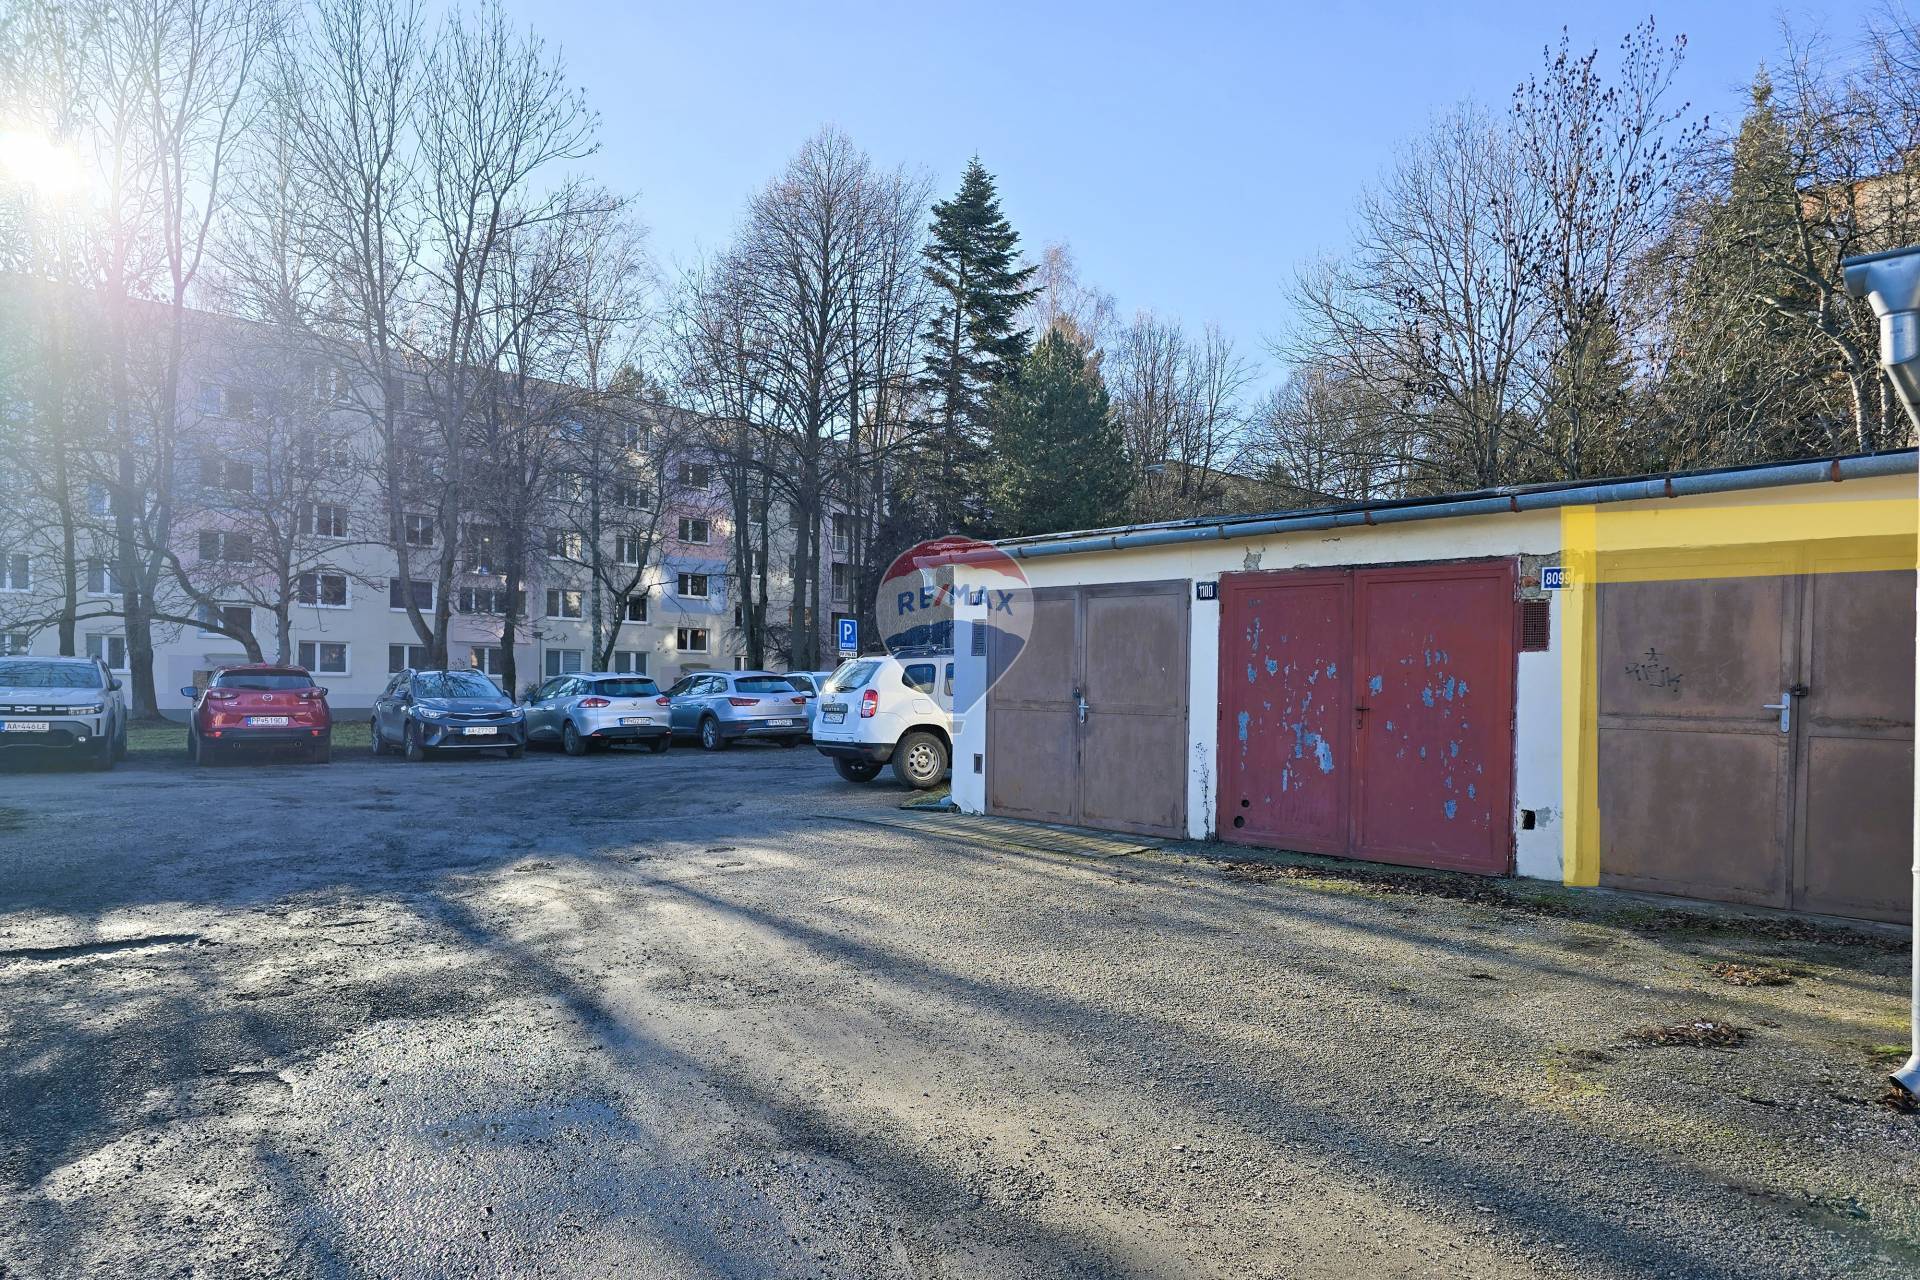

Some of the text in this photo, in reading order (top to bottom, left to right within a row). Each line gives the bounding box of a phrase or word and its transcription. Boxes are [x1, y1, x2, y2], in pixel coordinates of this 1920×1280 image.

[1545, 571, 1571, 586] 8099
[1198, 584, 1213, 598] 1100
[844, 623, 853, 641] P
